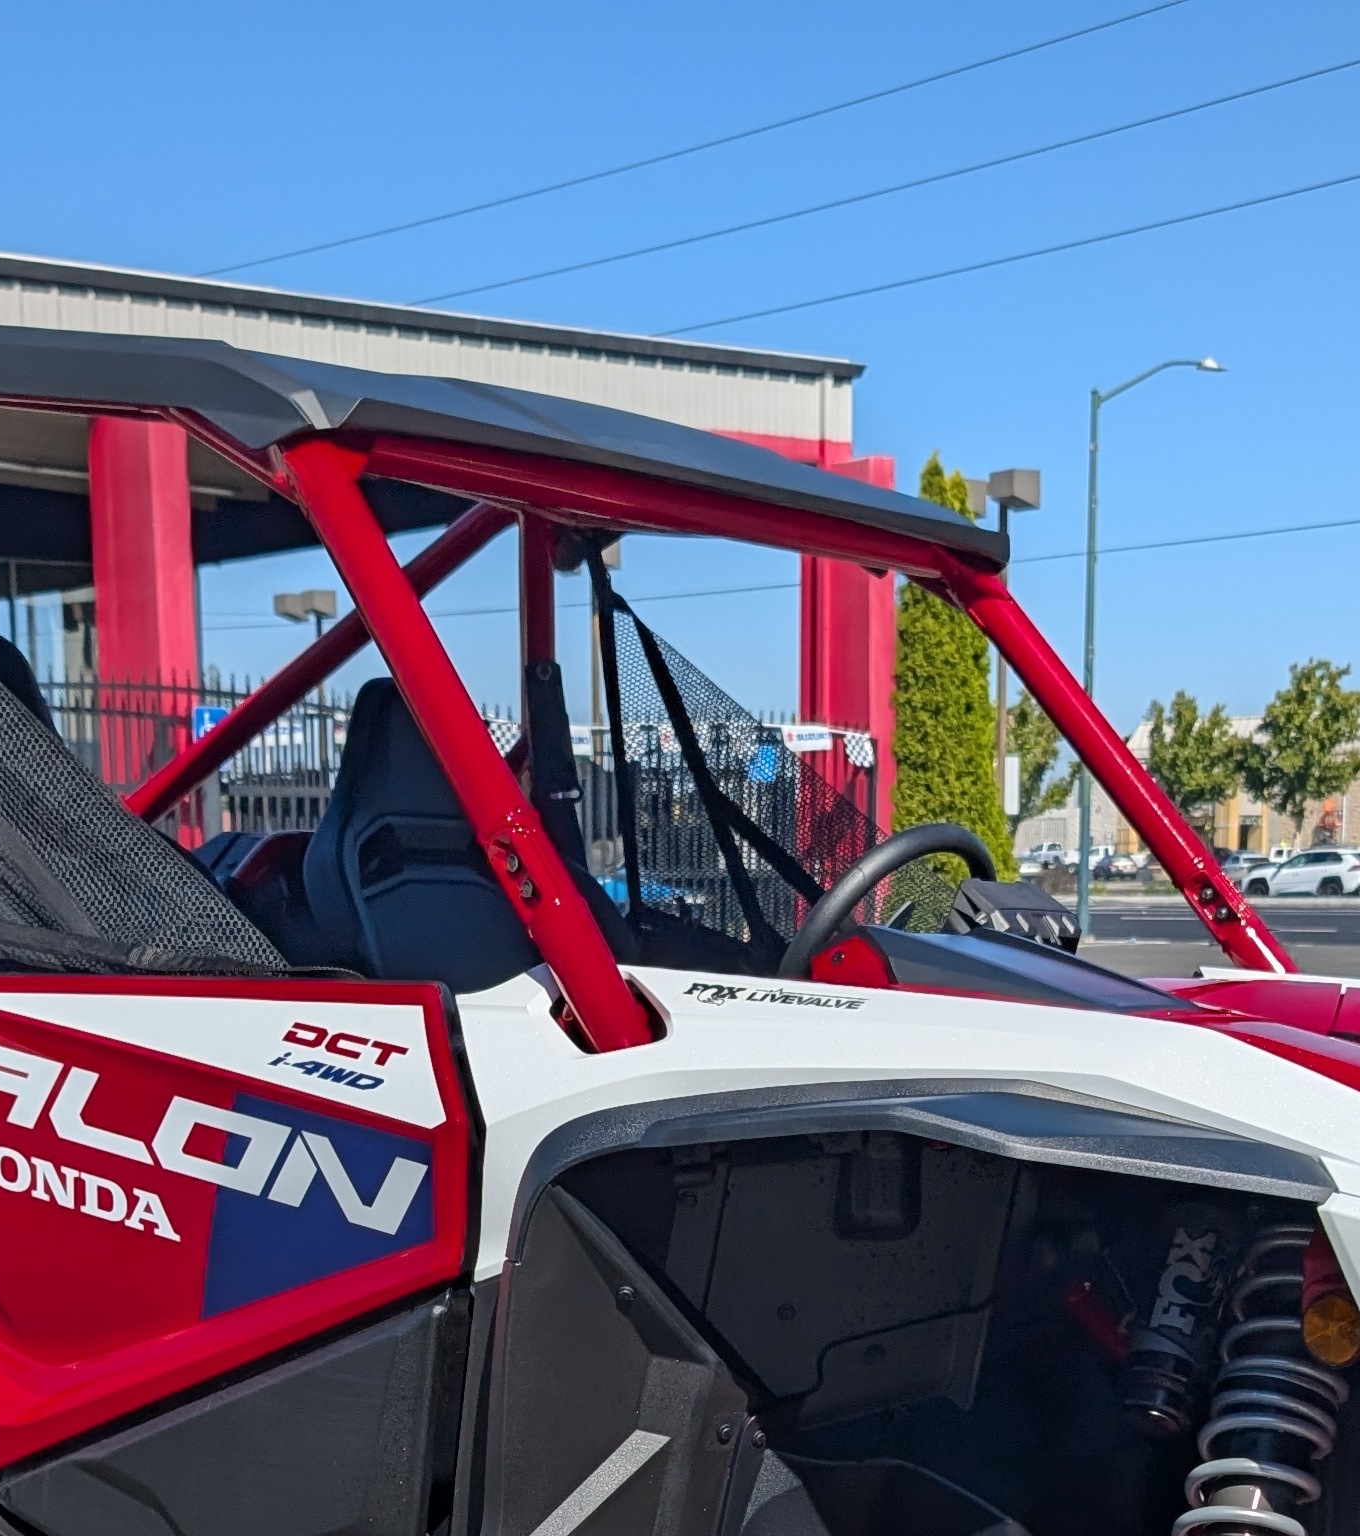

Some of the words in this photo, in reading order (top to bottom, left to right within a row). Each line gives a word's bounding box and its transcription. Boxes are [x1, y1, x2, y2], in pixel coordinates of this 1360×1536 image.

[683, 982, 747, 1003] FOX
[745, 990, 866, 1010] LIVEVALVE
[281, 1021, 410, 1067] DCT
[1149, 1226, 1217, 1335] FOX
